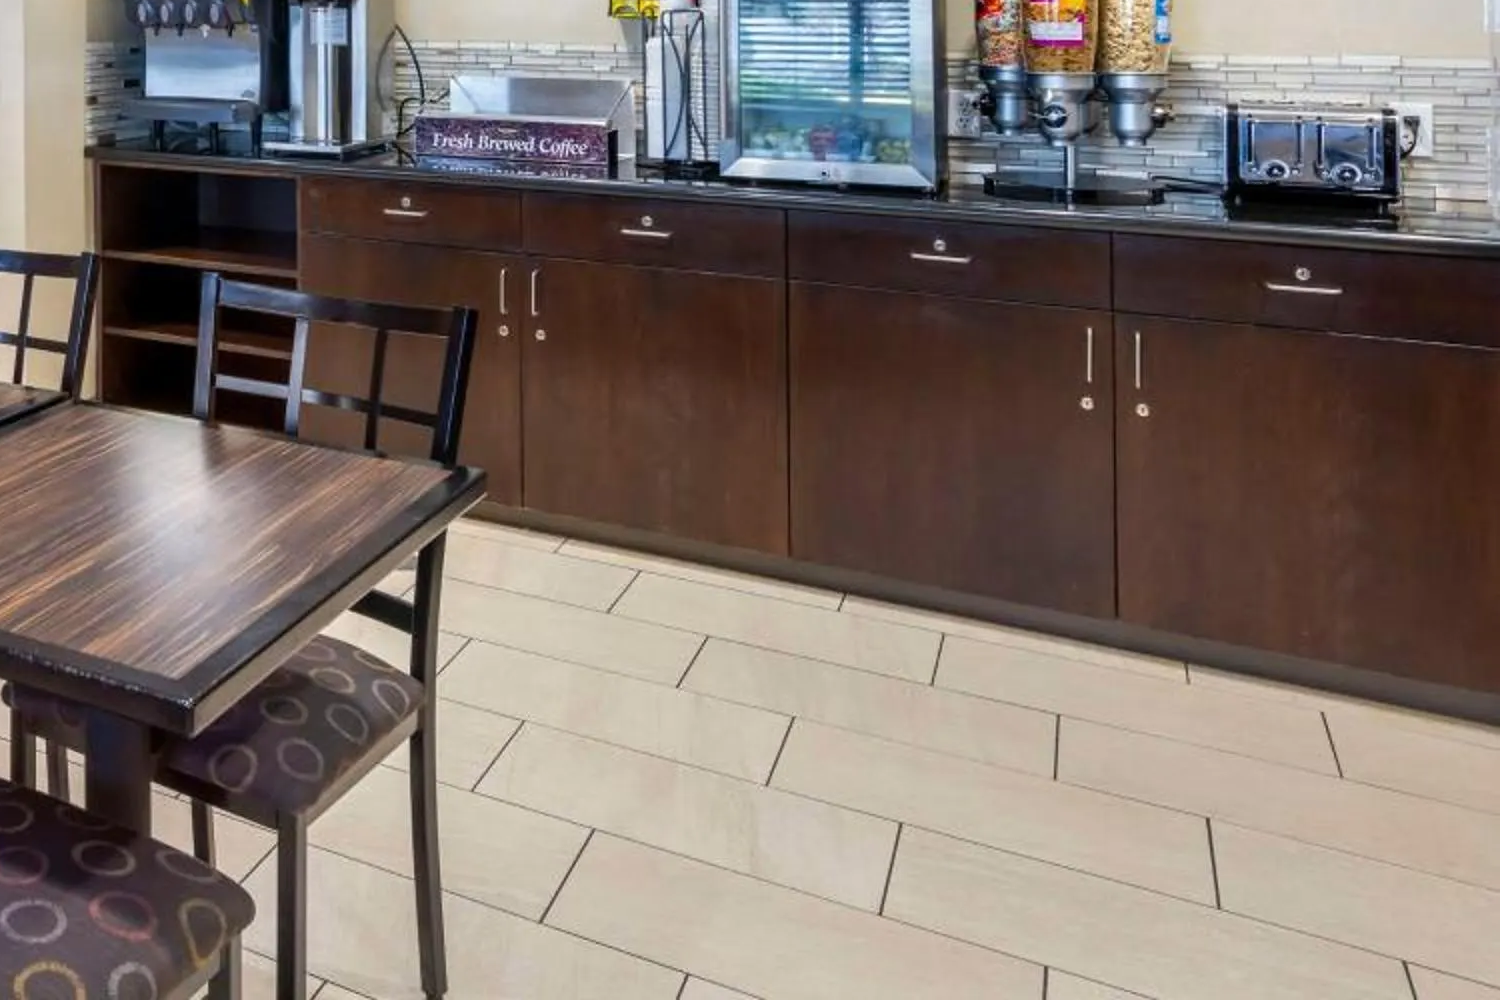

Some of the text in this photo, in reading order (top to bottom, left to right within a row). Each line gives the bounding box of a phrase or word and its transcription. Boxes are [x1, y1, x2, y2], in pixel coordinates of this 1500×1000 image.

[432, 132, 589, 159] Fresh Brewed Coffee
